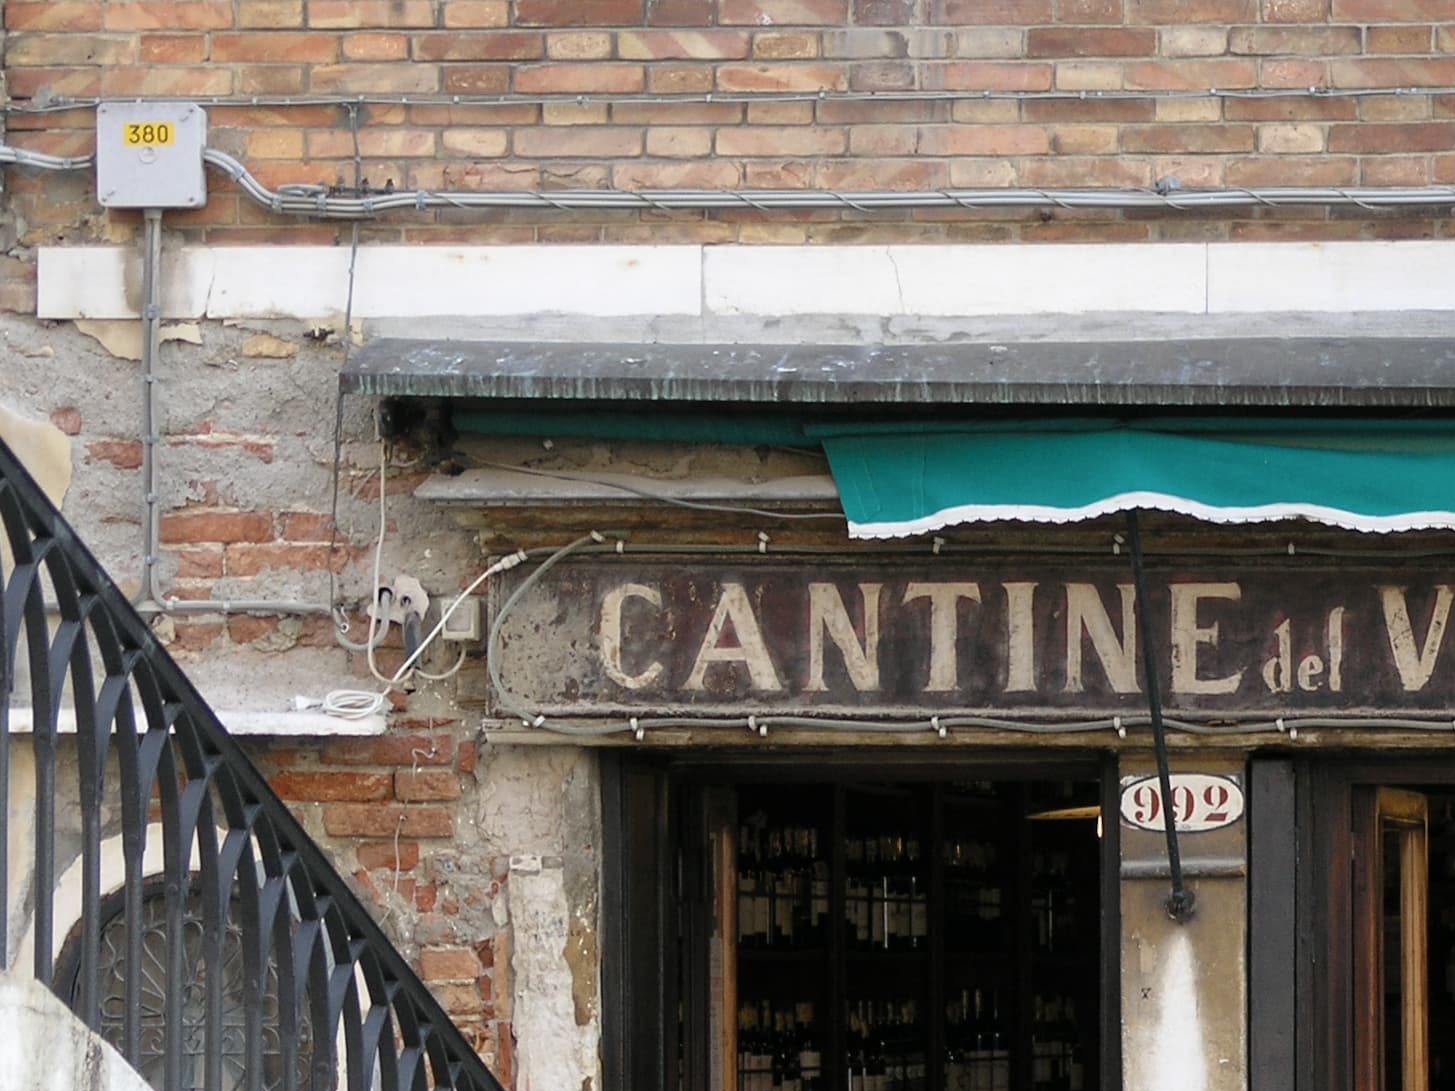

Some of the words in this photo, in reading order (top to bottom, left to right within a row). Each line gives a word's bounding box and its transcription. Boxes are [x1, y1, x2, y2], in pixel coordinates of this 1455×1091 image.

[129, 124, 168, 144] 380
[600, 581, 1243, 695] CANTINE
[1262, 606, 1344, 694] del
[1134, 785, 1229, 822] 992
